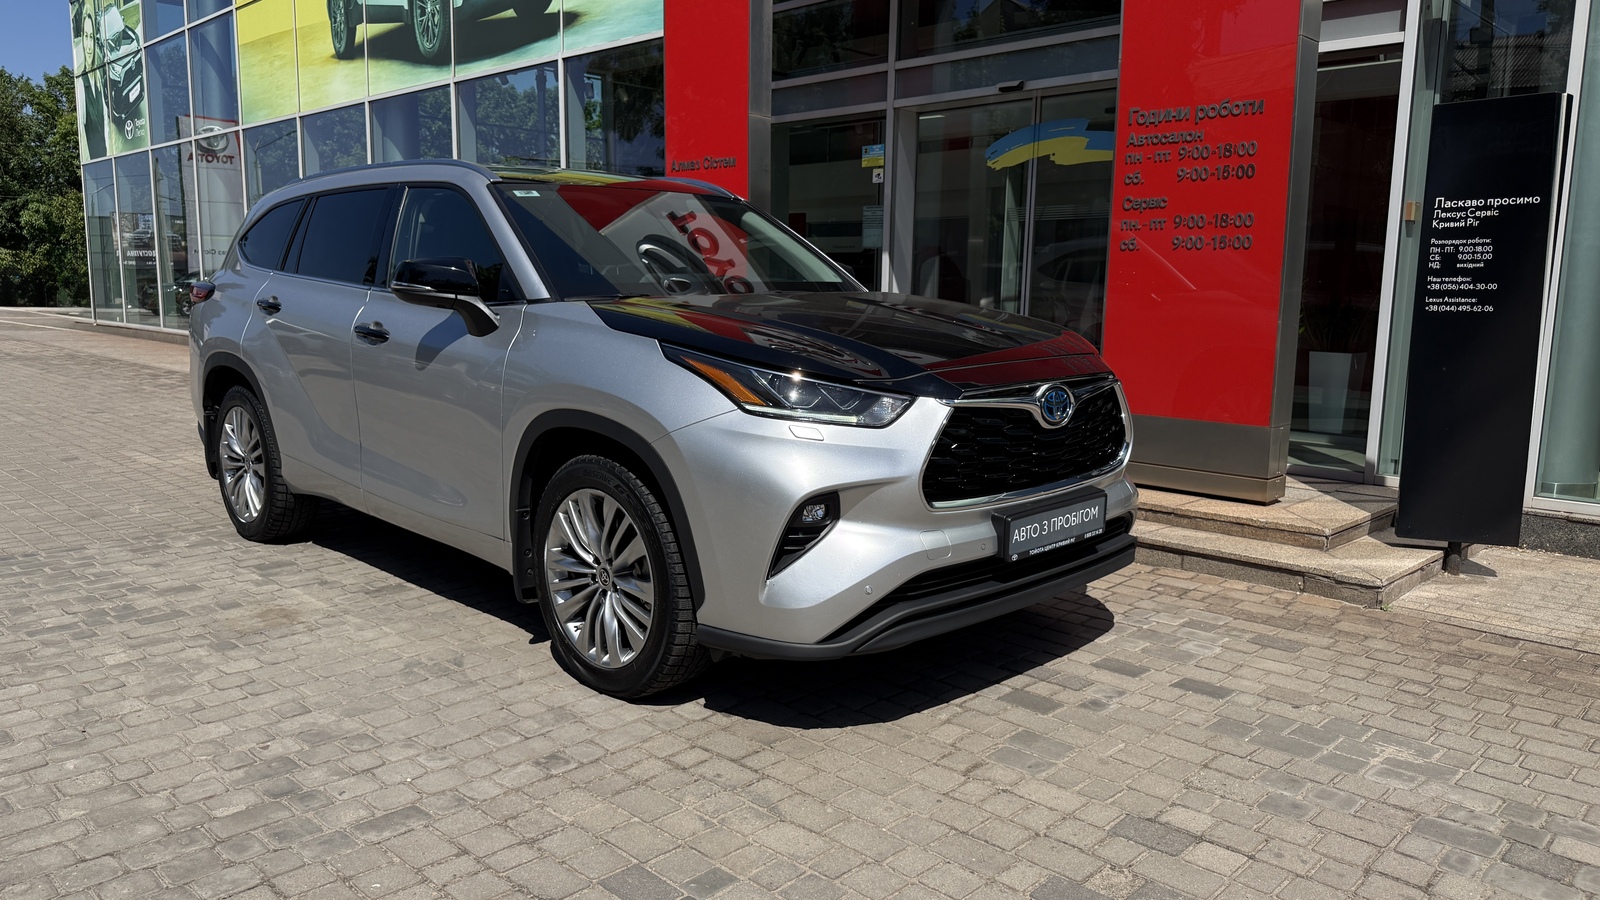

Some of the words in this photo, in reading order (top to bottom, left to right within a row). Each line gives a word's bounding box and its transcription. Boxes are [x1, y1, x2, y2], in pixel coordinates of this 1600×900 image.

[1128, 106, 1191, 128] Години
[1195, 98, 1265, 125] роботи
[1126, 130, 1205, 148] Автосалон
[671, 160, 701, 173] Алмаз
[703, 156, 737, 170] Сістем
[1176, 163, 1256, 183] 9:00-15:00
[1122, 196, 1168, 214] Сервіс
[1434, 197, 1485, 209] Ласкаво
[1487, 196, 1541, 207] просимо
[1433, 209, 1467, 219] Лексус
[1467, 208, 1500, 218] Сервіс
[1432, 219, 1465, 229] Кривий
[1466, 218, 1480, 227] Ріг
[1172, 234, 1253, 250] 9:00-15:00
[1458, 245, 1493, 253] 9.00-18.00
[1456, 261, 1484, 269] вихідний
[1440, 283, 1459, 291] (056)
[1438, 305, 1457, 313] (044)
[1012, 523, 1040, 543] АВТО
[1050, 505, 1099, 532] ПРОБІГОМ
